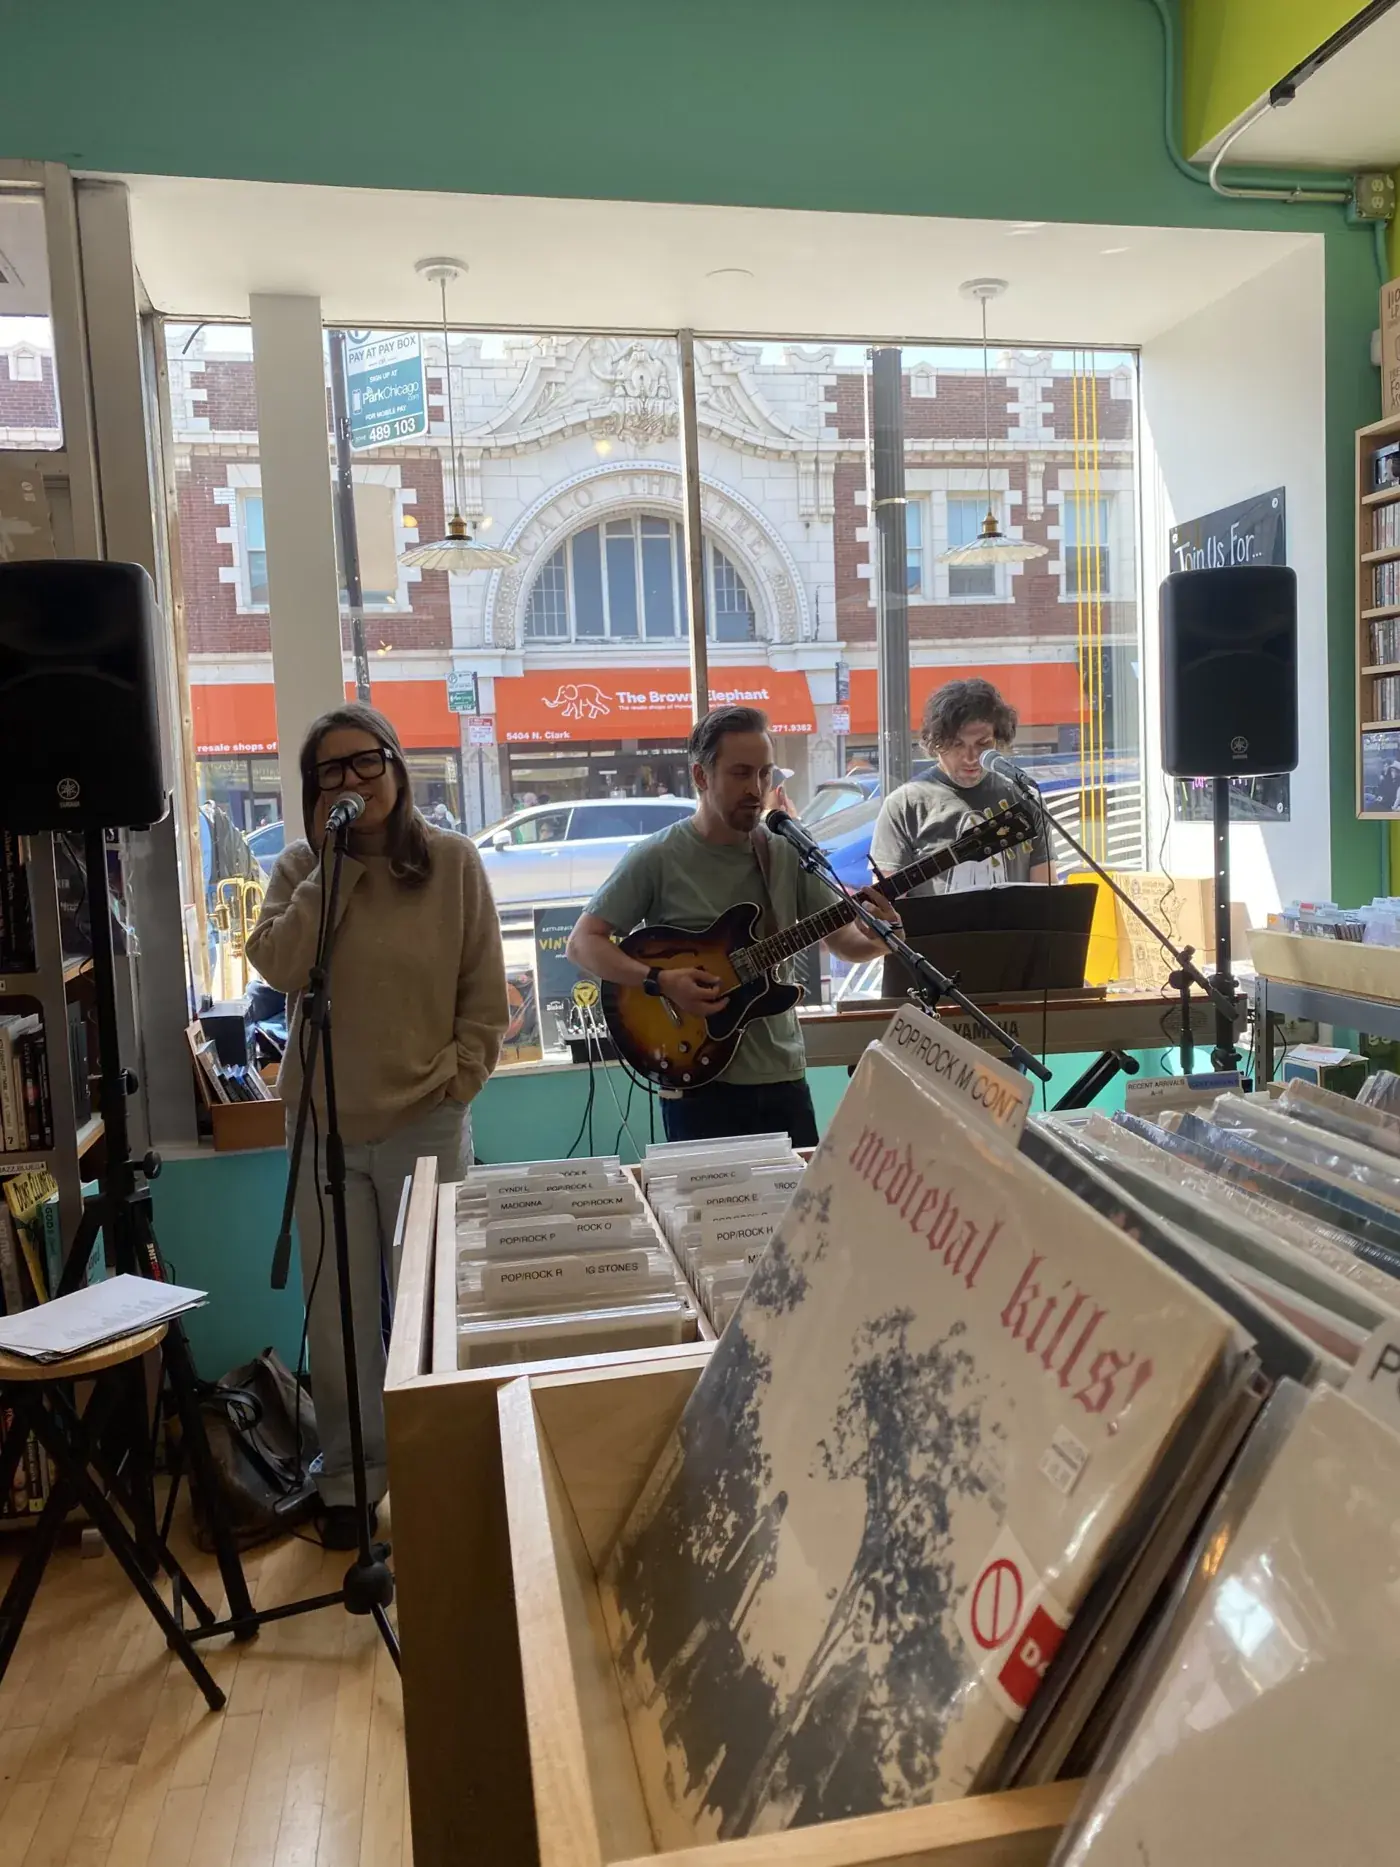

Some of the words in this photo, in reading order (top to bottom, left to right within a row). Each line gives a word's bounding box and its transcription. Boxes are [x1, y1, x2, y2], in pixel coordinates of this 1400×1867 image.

[348, 351, 365, 364] PAY
[366, 346, 377, 360] AT
[378, 343, 395, 356] PAY
[397, 335, 417, 350] BOX
[369, 375, 382, 383] SIGN
[382, 372, 391, 380] UP
[390, 369, 399, 377] AT
[365, 413, 376, 421] FOR
[376, 408, 396, 419] MOBILE
[396, 404, 407, 413] PAY
[369, 424, 391, 442] 489
[393, 417, 416, 436] 103
[517, 486, 594, 556] CALO
[618, 472, 767, 557] THETRE
[1207, 535, 1225, 568] Us
[1230, 521, 1262, 566] For...
[615, 691, 646, 704] The
[506, 732, 530, 741] 5404
[545, 730, 570, 739] Clark
[197, 743, 230, 752] resale
[232, 741, 264, 752] shops
[266, 741, 277, 750] of
[889, 1018, 960, 1080] POP/ROCK
[954, 1063, 976, 1091] M
[1128, 1082, 1154, 1090] RECENT
[1154, 1079, 1185, 1088] ARRIVALS
[690, 1173, 728, 1182] POP/ROCK
[546, 1184, 587, 1192] POP/ROCK
[500, 1200, 543, 1210] MADONNA
[571, 1198, 616, 1208] POP/ROCK
[616, 1197, 624, 1205] M
[706, 1195, 750, 1206] POP/ROCK
[849, 1123, 1006, 1289] medieval
[499, 1234, 547, 1245] POP/ROCK
[716, 1227, 765, 1242] POP/ROCK
[766, 1226, 774, 1234] H
[500, 1270, 554, 1283] POP/ROCK
[555, 1269, 563, 1278] R
[597, 1262, 639, 1274] STONES
